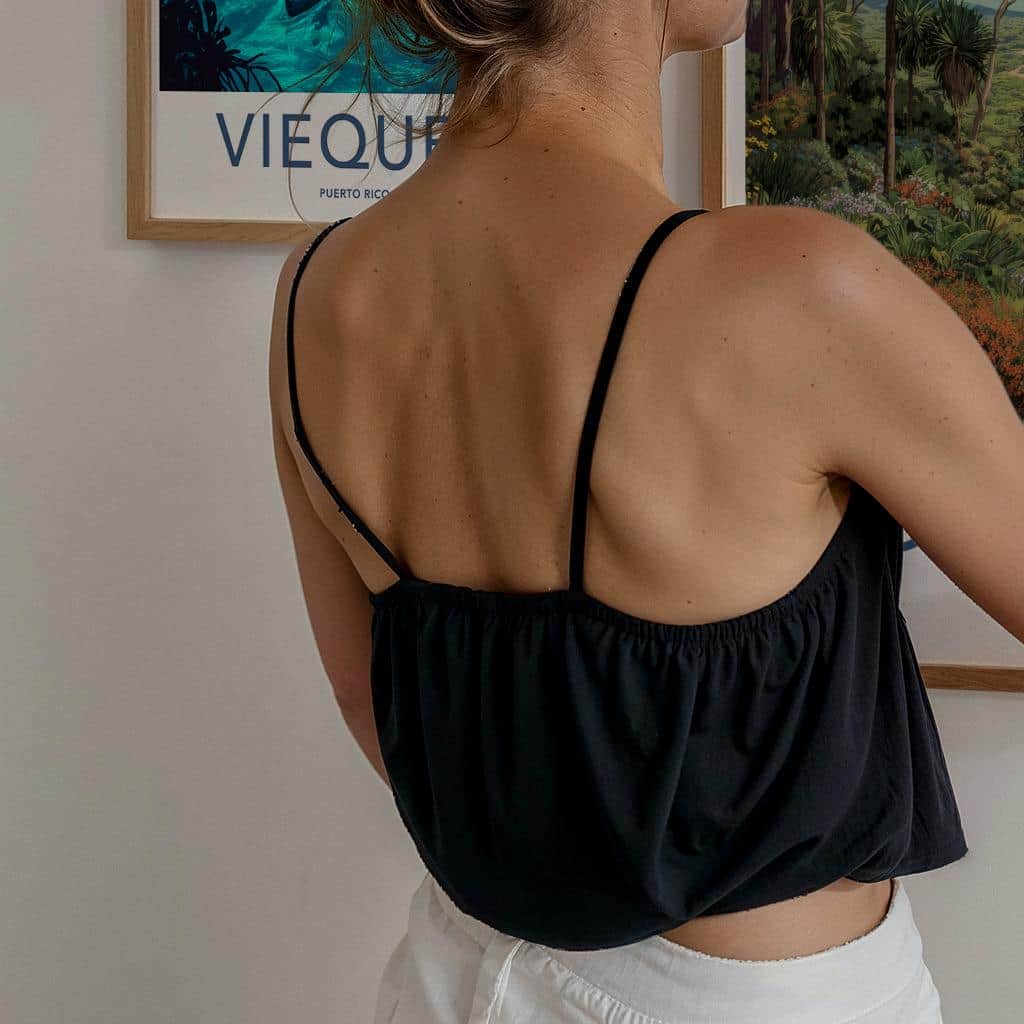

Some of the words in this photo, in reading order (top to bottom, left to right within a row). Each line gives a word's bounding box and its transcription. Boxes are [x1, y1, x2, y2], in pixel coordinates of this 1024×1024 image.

[215, 112, 449, 171] VIEQUE
[319, 188, 361, 199] PUERTO
[364, 189, 389, 199] RICO
